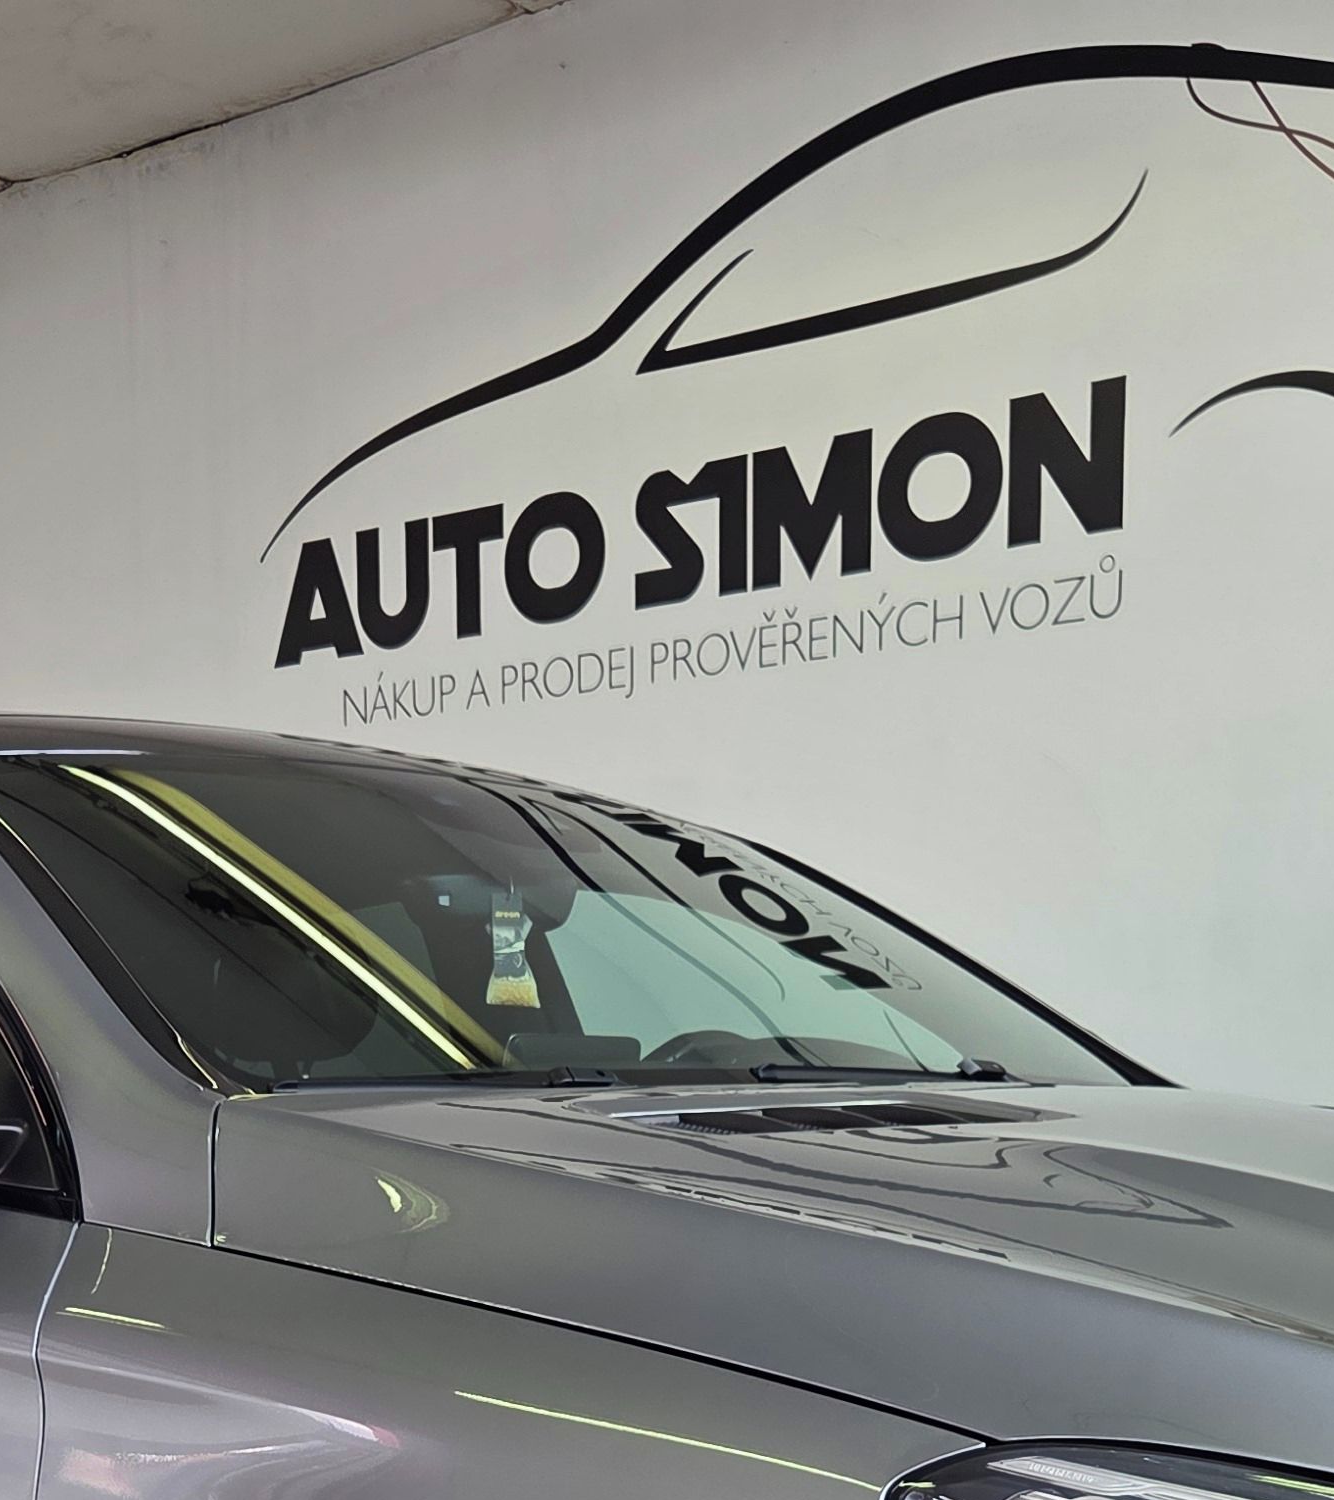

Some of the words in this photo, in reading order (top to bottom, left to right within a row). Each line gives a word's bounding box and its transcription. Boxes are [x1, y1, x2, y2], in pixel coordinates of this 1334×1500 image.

[275, 492, 605, 668] AUTO
[635, 376, 1127, 610] SIMON
[343, 671, 457, 727] NÁKUP
[465, 668, 491, 711] A
[501, 645, 635, 704] PRODEJ
[651, 592, 964, 684] PROVĚŘENÝCH
[979, 555, 1124, 635] VOZŮ
